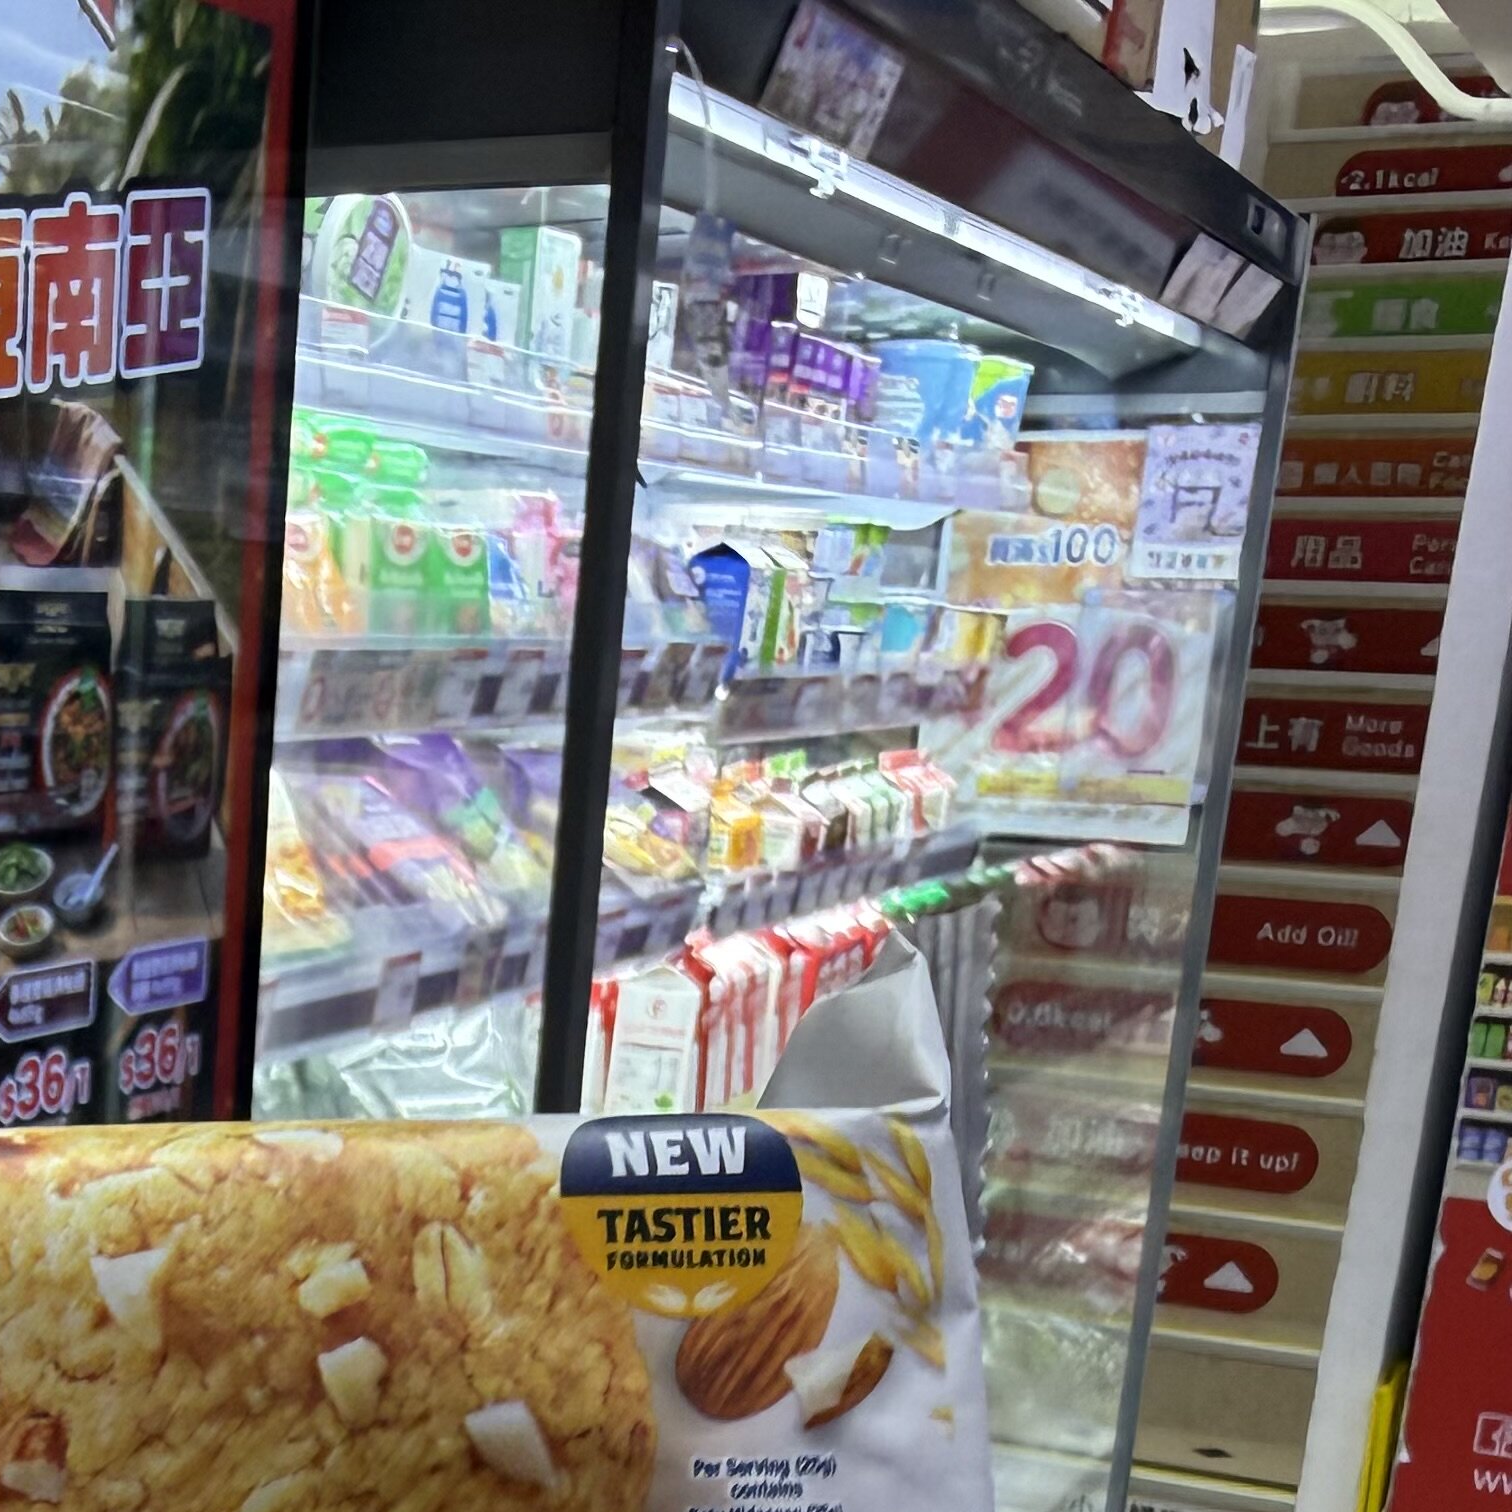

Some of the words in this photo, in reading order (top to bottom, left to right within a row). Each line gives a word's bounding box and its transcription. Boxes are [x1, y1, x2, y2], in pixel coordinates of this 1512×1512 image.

[992, 623, 1176, 759] 20
[1256, 922, 1306, 944] Add
[605, 1126, 746, 1177] NEW
[597, 1205, 771, 1243] TASTIER
[607, 1248, 766, 1271] FORMULATION
[726, 1457, 790, 1480] Serving
